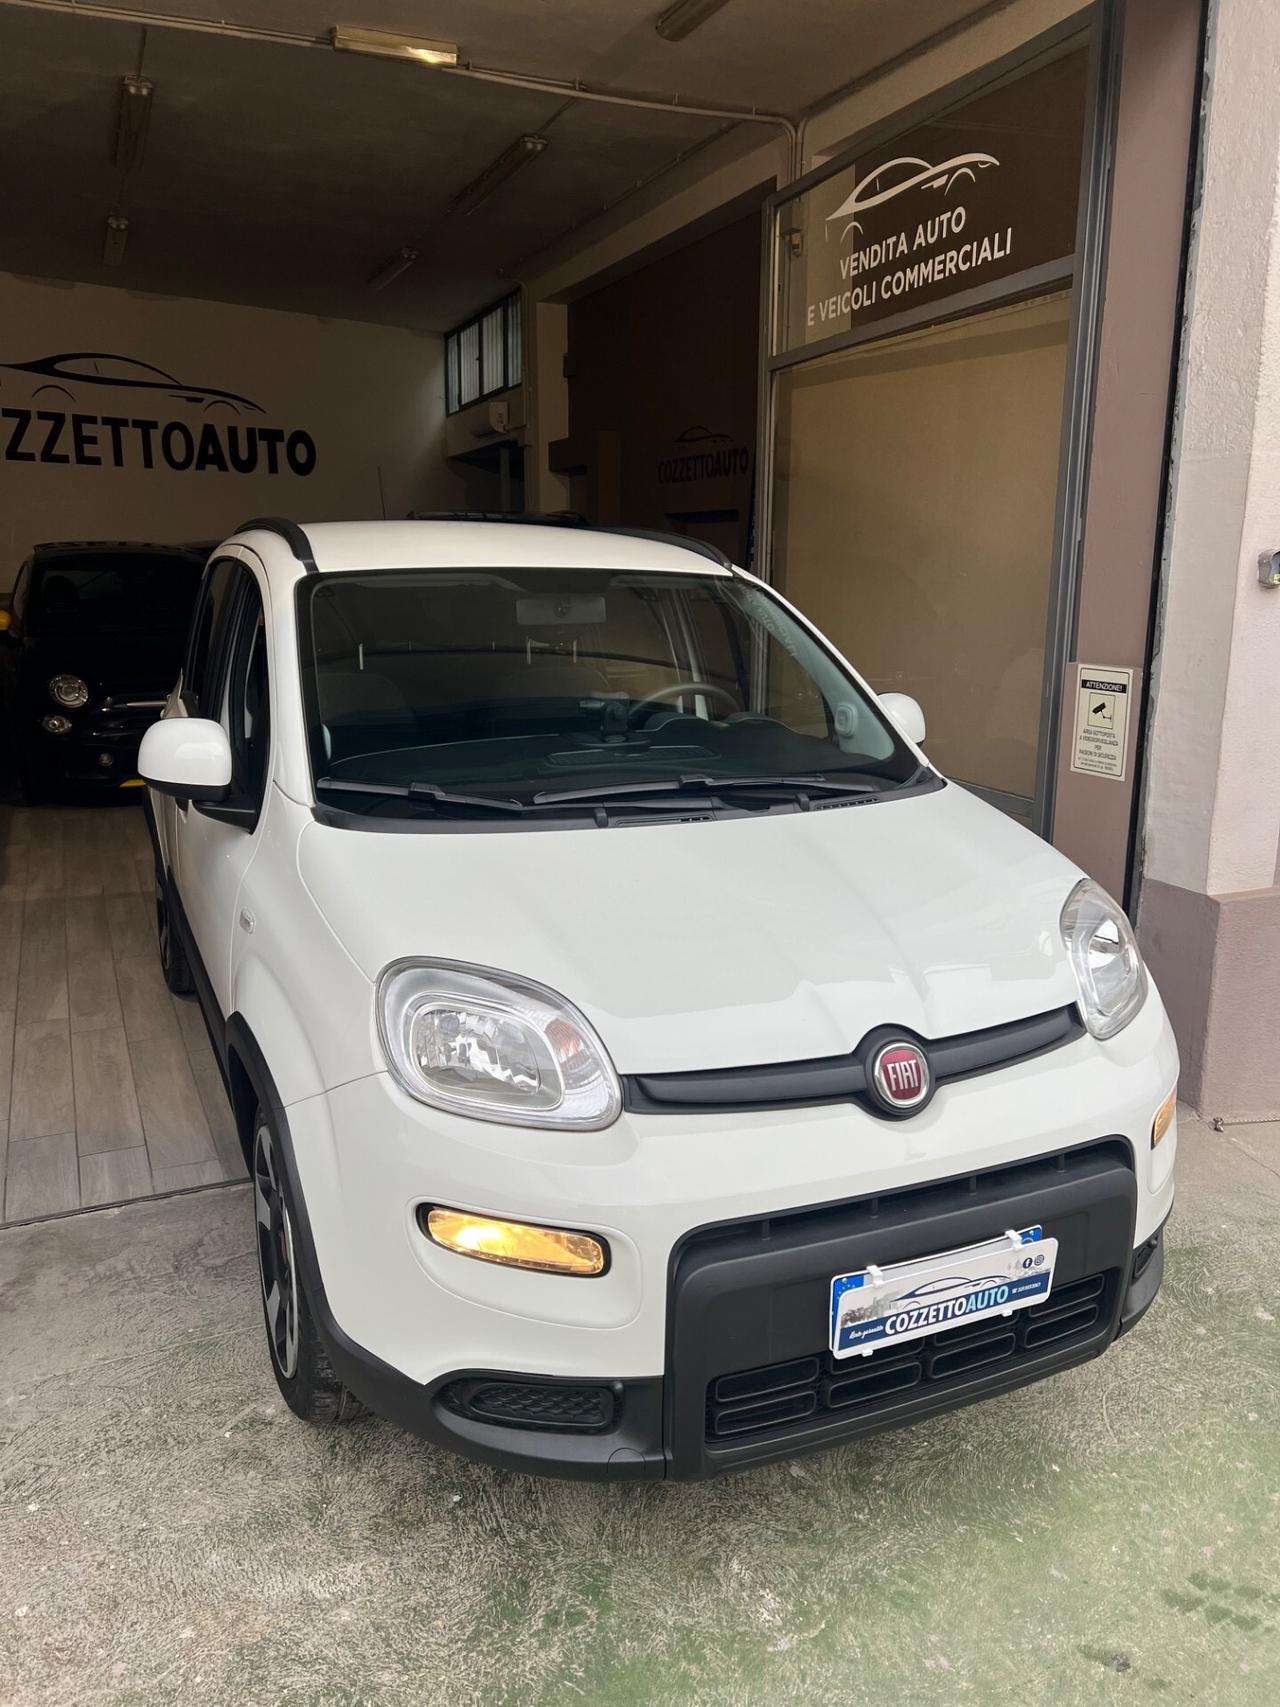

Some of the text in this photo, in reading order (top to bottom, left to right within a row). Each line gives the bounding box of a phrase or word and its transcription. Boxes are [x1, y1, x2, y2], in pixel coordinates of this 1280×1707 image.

[840, 206, 966, 280] VENDITA AUTO
[807, 227, 1012, 327] E VEICOLI COMMERCIALI
[658, 447, 749, 485] COZZETTOAUTO
[1085, 681, 1123, 692] ATTENZIONE!
[887, 1059, 918, 1092] FIAT
[885, 1286, 1009, 1335] COZZETTOAUTO
